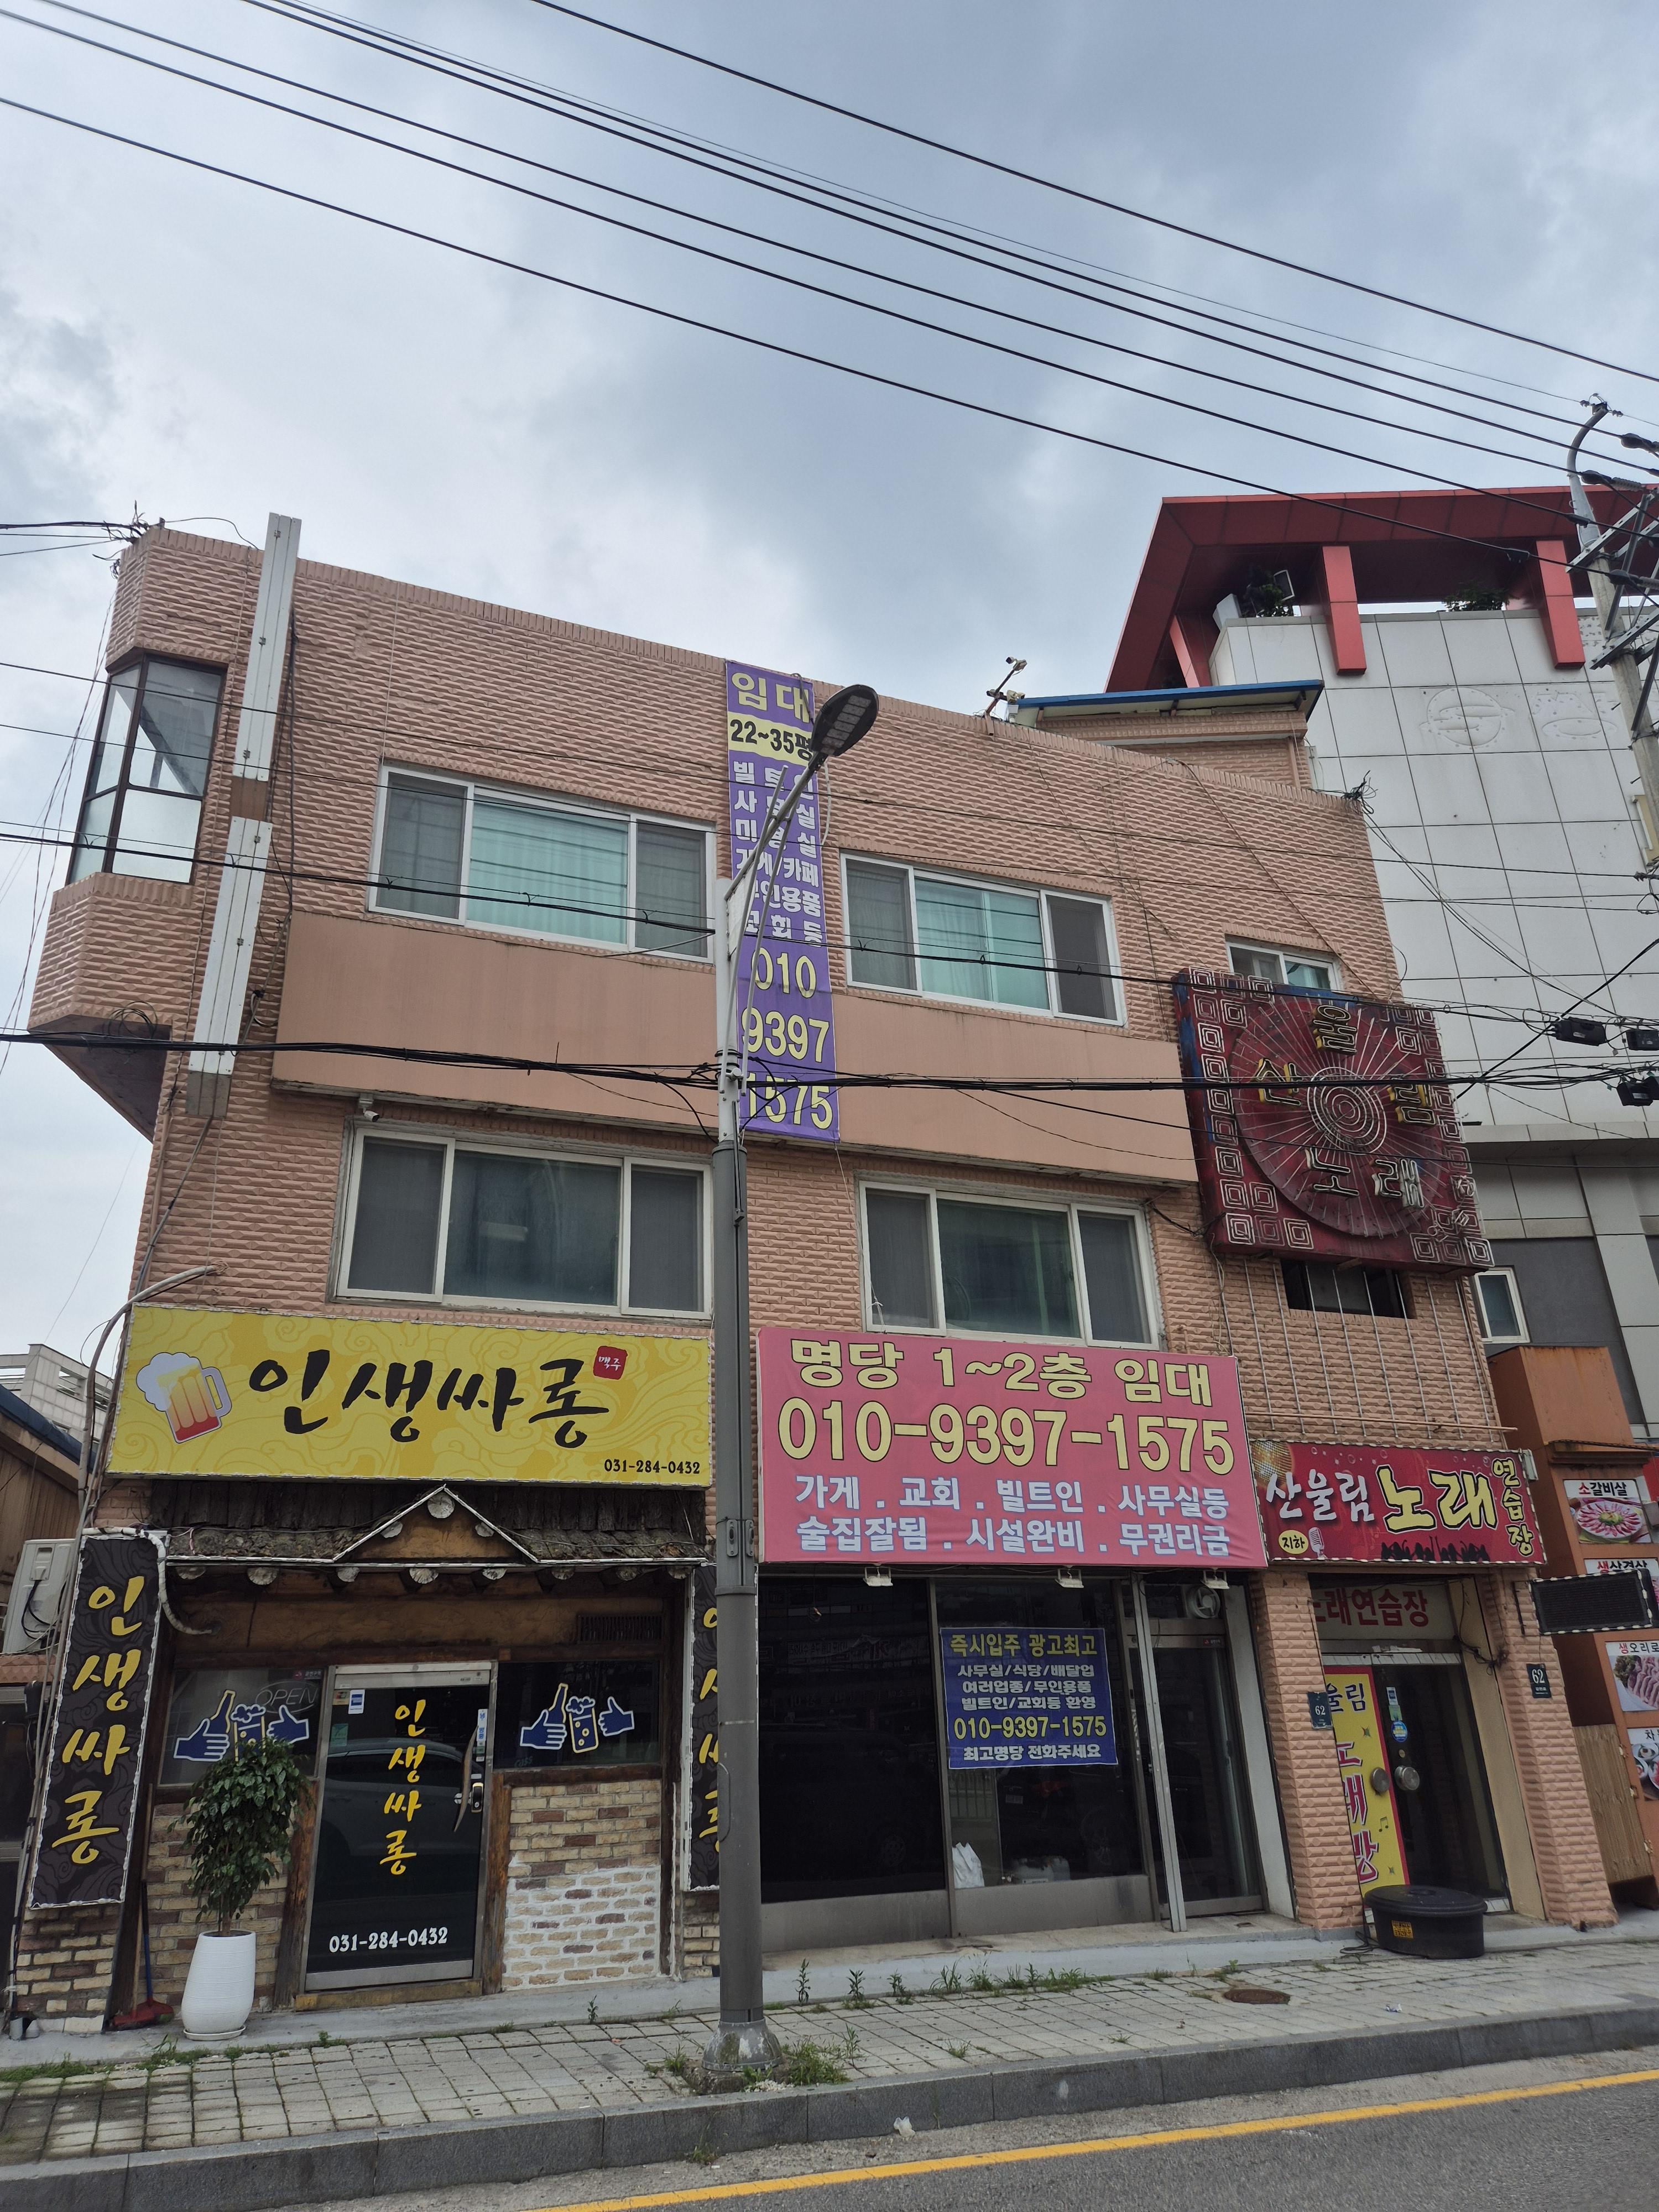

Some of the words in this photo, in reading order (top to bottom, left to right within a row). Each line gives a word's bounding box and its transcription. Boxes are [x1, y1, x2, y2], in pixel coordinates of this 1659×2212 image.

[732, 672, 810, 723] 임대
[730, 719, 813, 761] 22~35평
[754, 879, 822, 917] 인용품
[751, 947, 817, 998] 010
[741, 1006, 830, 1063] 9397
[747, 1072, 833, 1130] 1575
[598, 1356, 622, 1371] 맥주
[791, 1339, 904, 1389] 명당
[933, 1347, 1092, 1400] 1~2층
[1114, 1359, 1213, 1407] 임대
[248, 1349, 609, 1449] 인생싸롱
[778, 1397, 1235, 1475] 010-9397-1575
[604, 1459, 701, 1475] 031-284-0432
[795, 1475, 860, 1510] 가게
[899, 1477, 961, 1510] 교회
[997, 1479, 1084, 1514] 빌트인
[1118, 1484, 1229, 1520] 사무실등
[1266, 1468, 1375, 1522] 산울림
[1375, 1463, 1499, 1535] 노래
[1492, 1457, 1535, 1557] 연습장
[1579, 1482, 1627, 1496] 소갈비살
[796, 1516, 927, 1552] 술집잘됨
[966, 1518, 1084, 1554] 시설완비
[1118, 1522, 1230, 1557] 무권리금
[1282, 1536, 1305, 1550] 지하
[950, 1633, 1021, 1657] 즉시입주
[1029, 1634, 1098, 1657] 광고최고
[1532, 1669, 1546, 1684] 62
[255, 1687, 319, 1707] OPEN
[1065, 1696, 1097, 1709] 환영
[1315, 1705, 1326, 1715] 62
[51, 1575, 145, 1864] 인생싸롱
[954, 1715, 1107, 1740] 010-9397-1575
[963, 1745, 1024, 1761] 최고명당
[1027, 1744, 1102, 1760] 전화주세요
[379, 1699, 427, 1875] 인생싸롱
[329, 1927, 448, 1953] 031-284-0432
